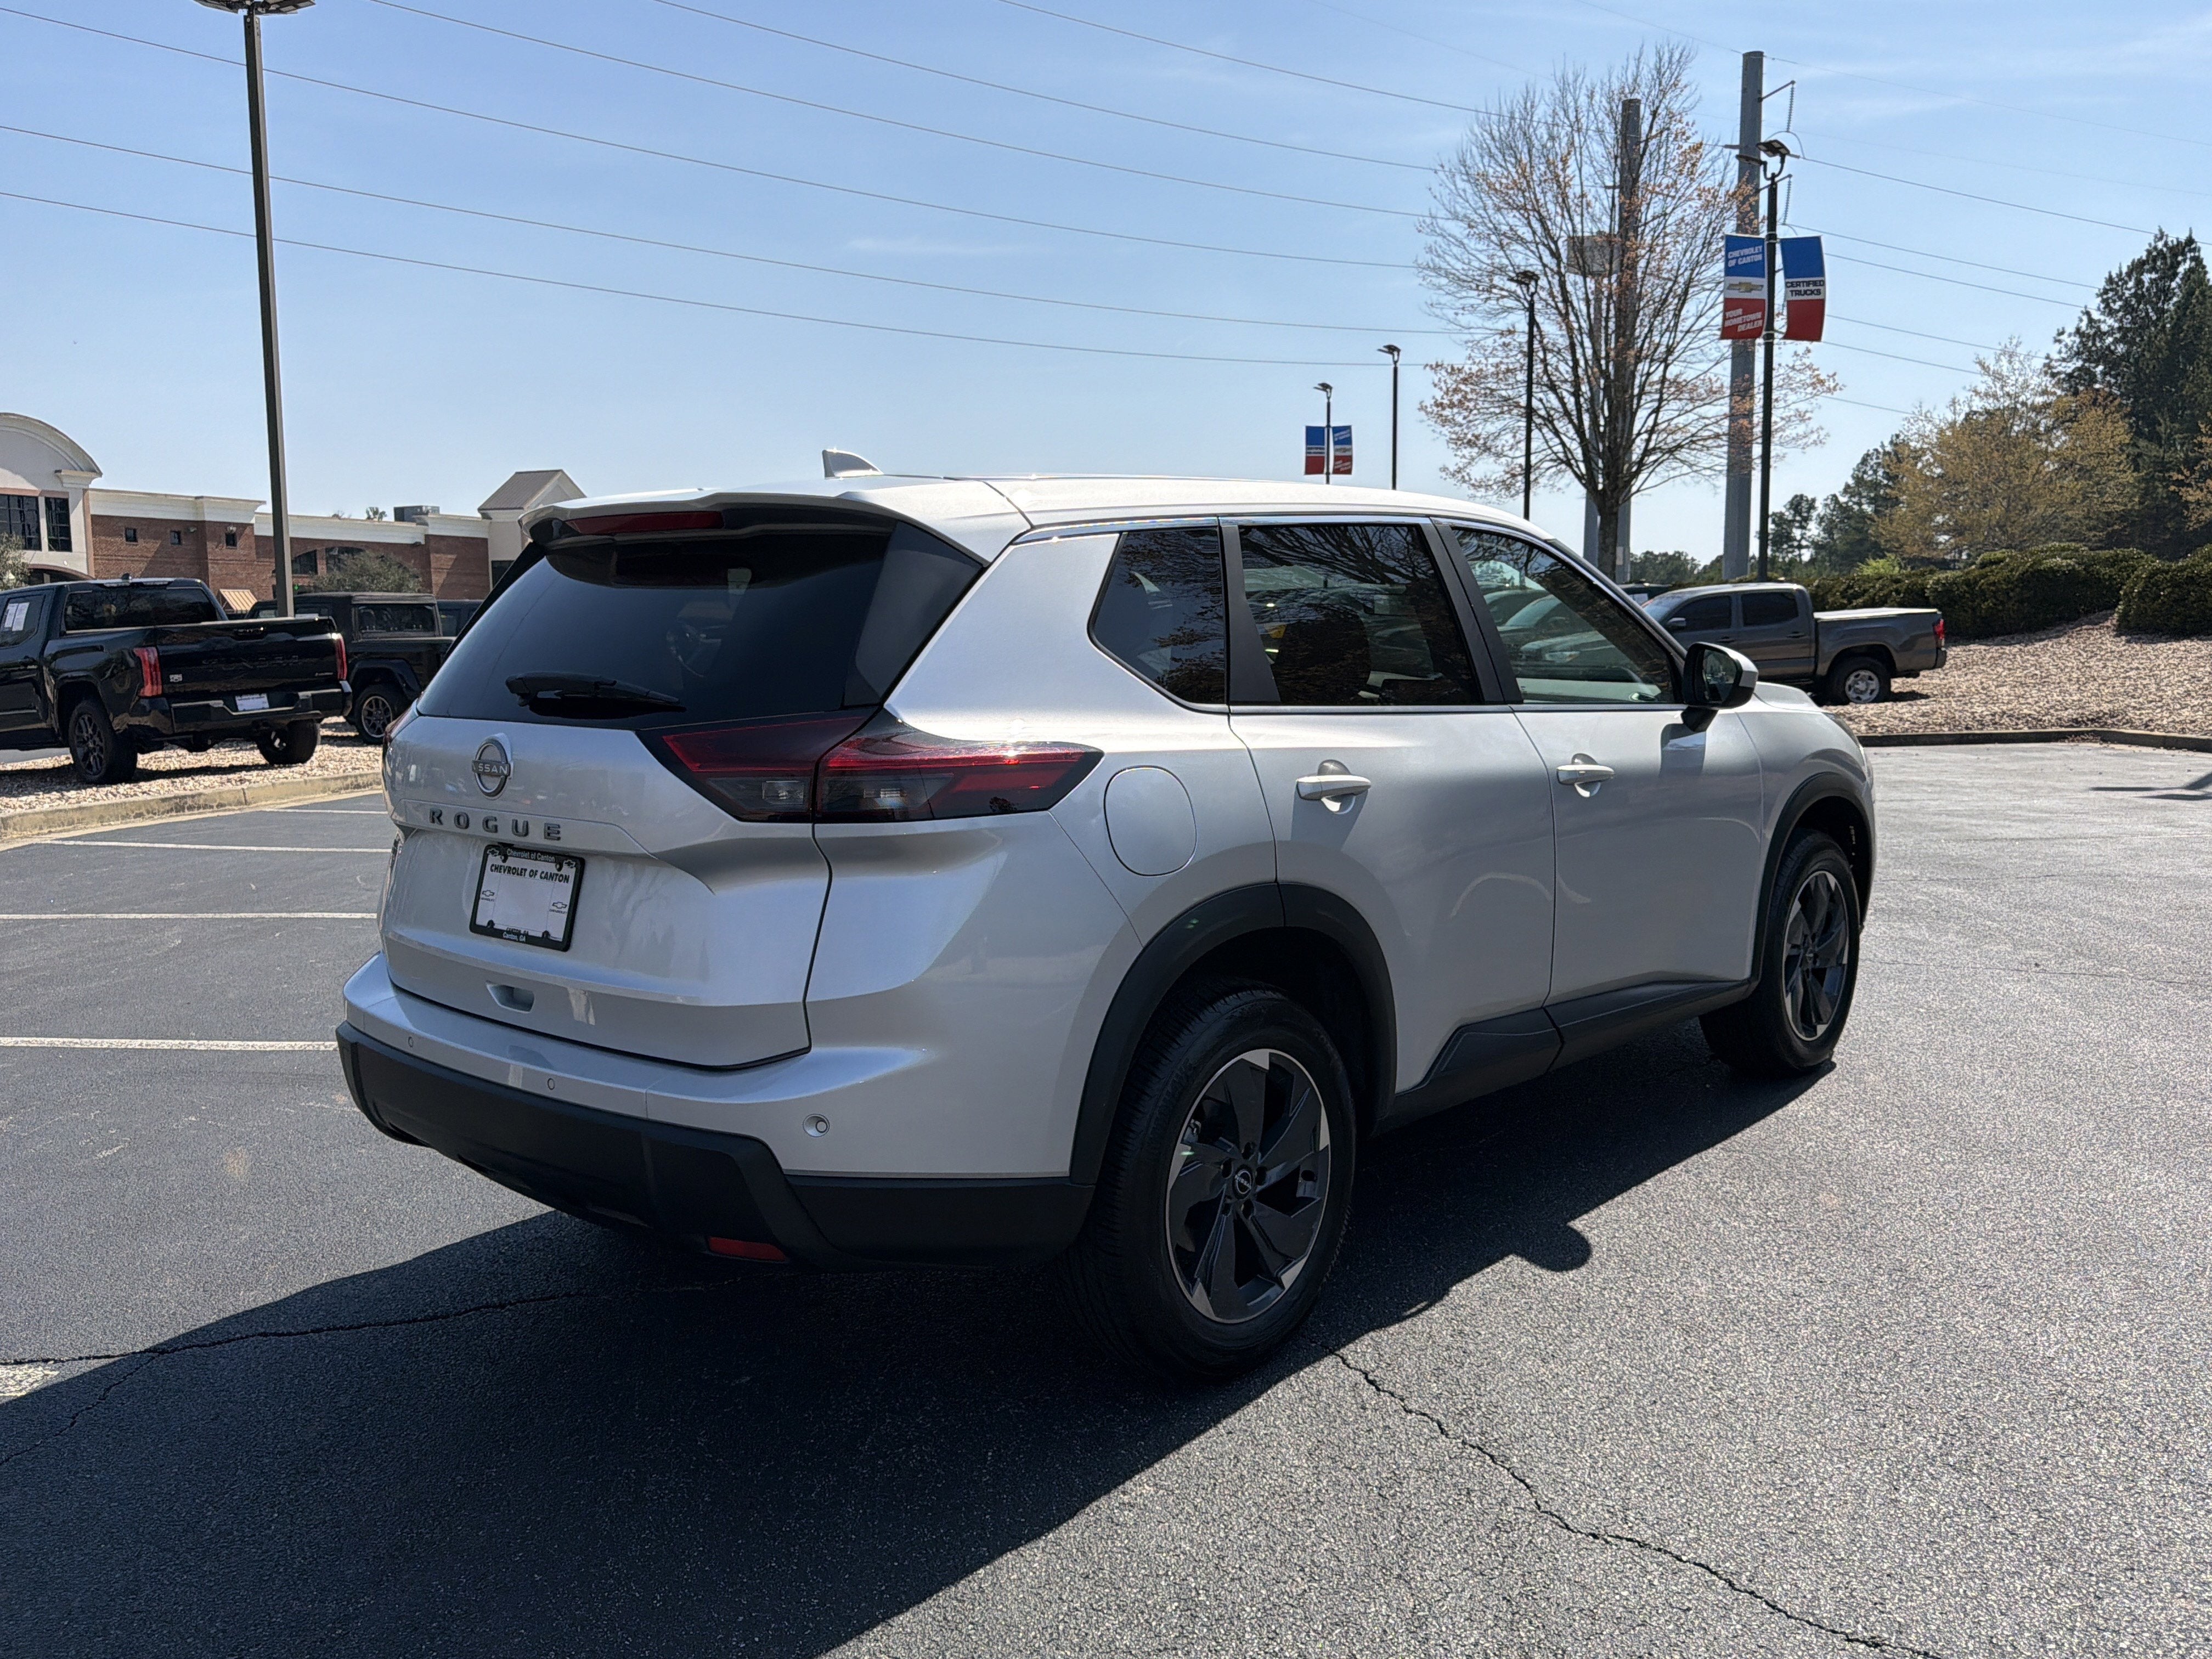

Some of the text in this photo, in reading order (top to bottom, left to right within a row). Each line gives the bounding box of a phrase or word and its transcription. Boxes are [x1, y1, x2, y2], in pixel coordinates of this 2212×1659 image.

[1786, 280, 1825, 288] CERTIFIED
[1790, 289, 1821, 297] TRUCKS
[429, 808, 561, 841] ROGUE
[506, 848, 530, 859] Chevrolet
[537, 853, 555, 862] Canton
[490, 864, 570, 884] CHEVROLET OF CANTON
